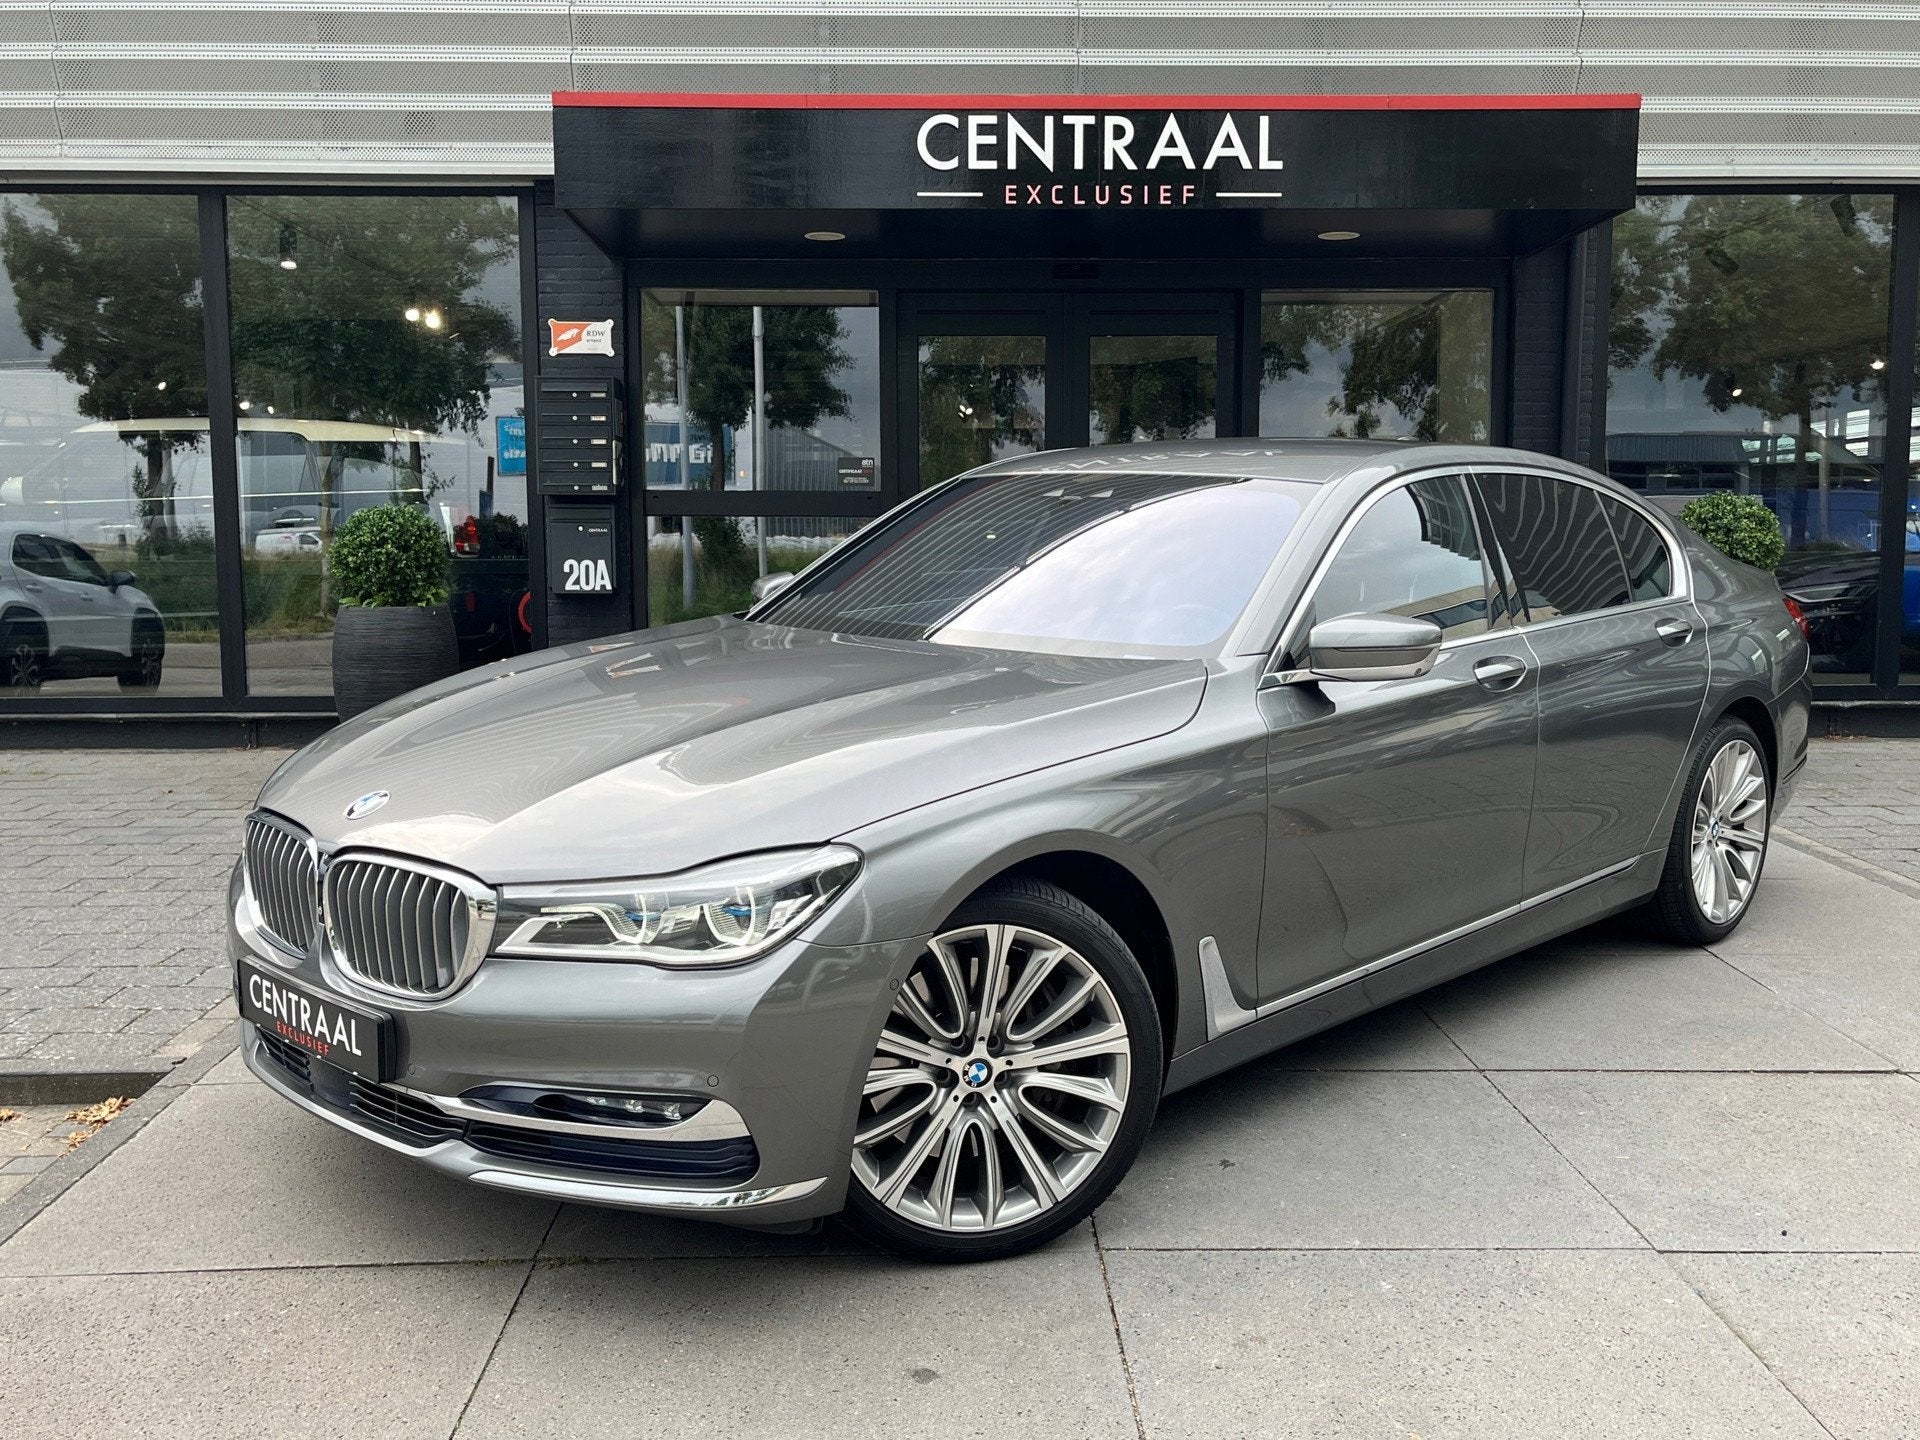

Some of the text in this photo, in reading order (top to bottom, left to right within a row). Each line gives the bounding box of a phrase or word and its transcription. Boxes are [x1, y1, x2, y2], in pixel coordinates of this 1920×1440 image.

[916, 111, 1284, 173] CENTRAAL
[1004, 184, 1196, 205] EXCLUSIEF
[563, 558, 613, 591] 20A
[249, 973, 363, 1057] CENTRAAL
[276, 1020, 331, 1057] EXCLUSIEF
